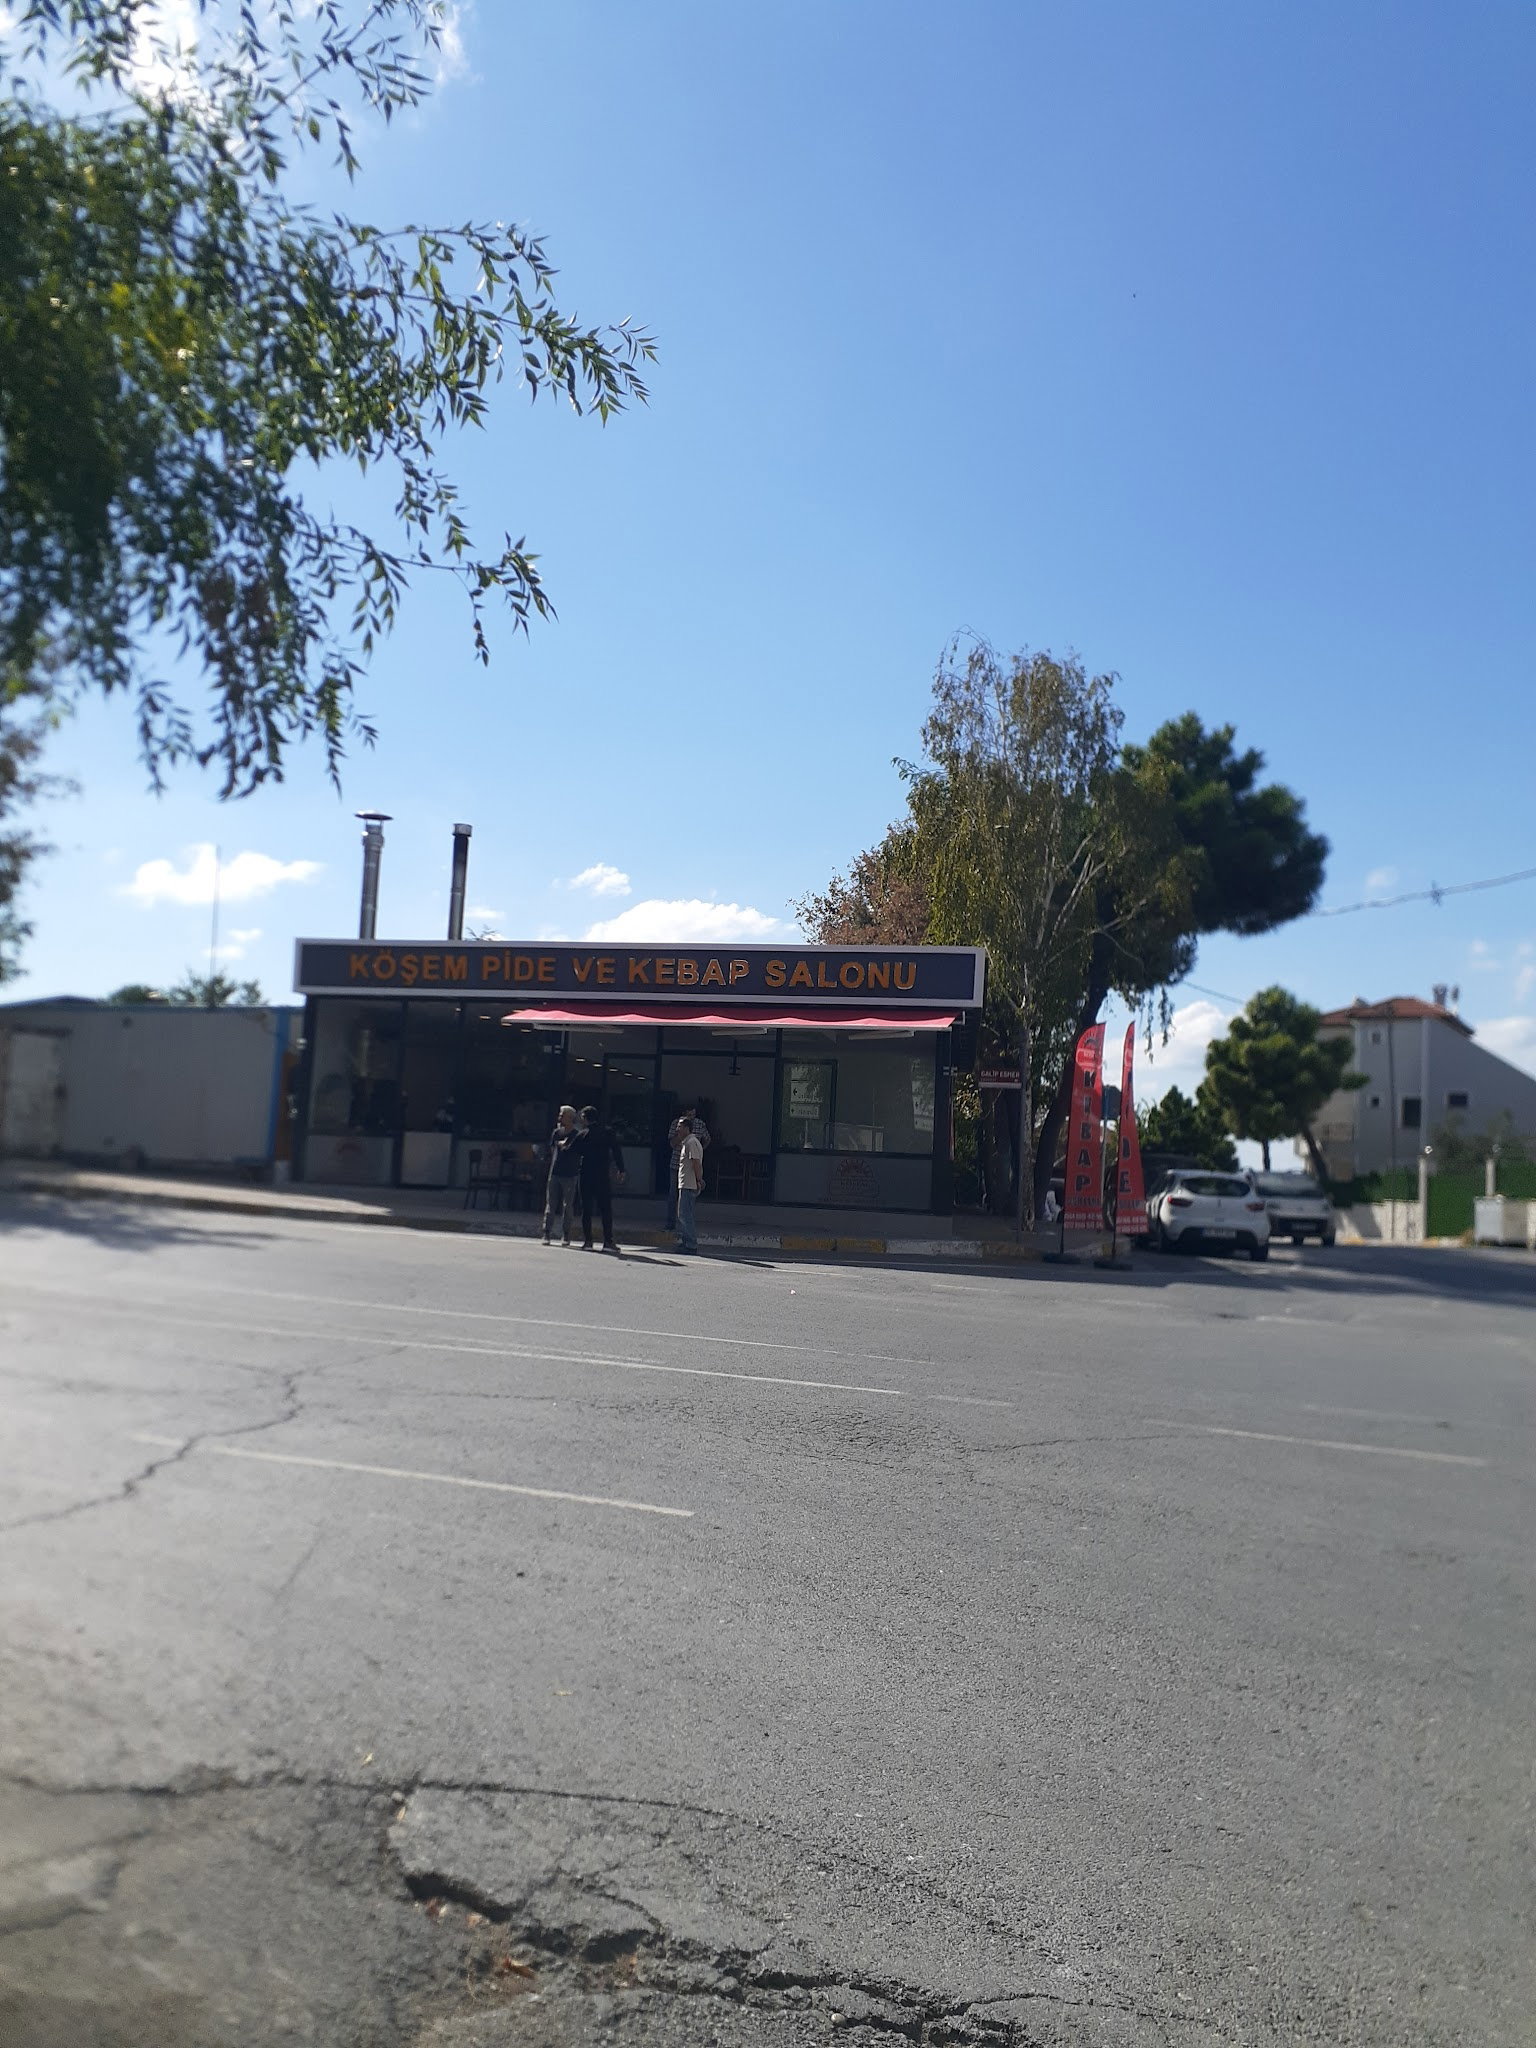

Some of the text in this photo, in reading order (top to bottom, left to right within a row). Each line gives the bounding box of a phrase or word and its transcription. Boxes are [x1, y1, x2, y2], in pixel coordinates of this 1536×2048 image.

[349, 949, 918, 991] KÖŞEM PİDE VE KEBAP SALONU
